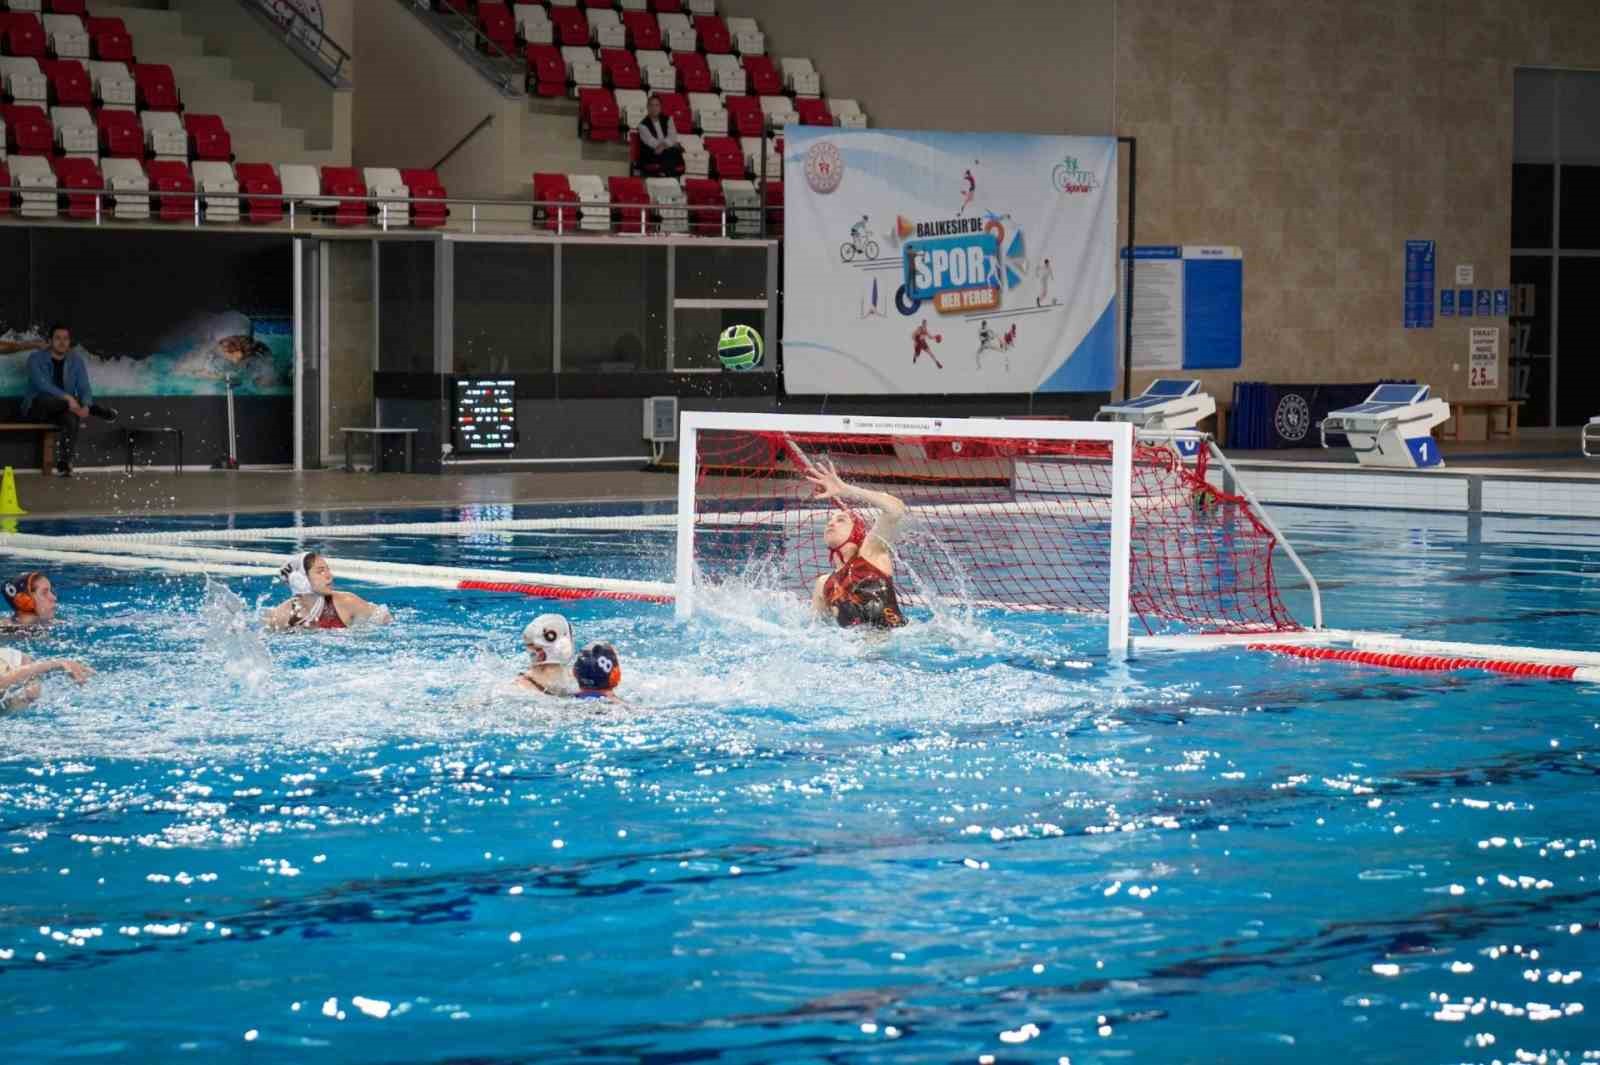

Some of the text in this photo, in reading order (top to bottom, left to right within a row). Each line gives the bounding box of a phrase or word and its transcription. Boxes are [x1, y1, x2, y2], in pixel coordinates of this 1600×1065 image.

[917, 217, 984, 237] BALIKESİR'DE
[914, 246, 985, 289] SPOR
[1419, 443, 1428, 461] 1
[598, 656, 612, 672] 8
